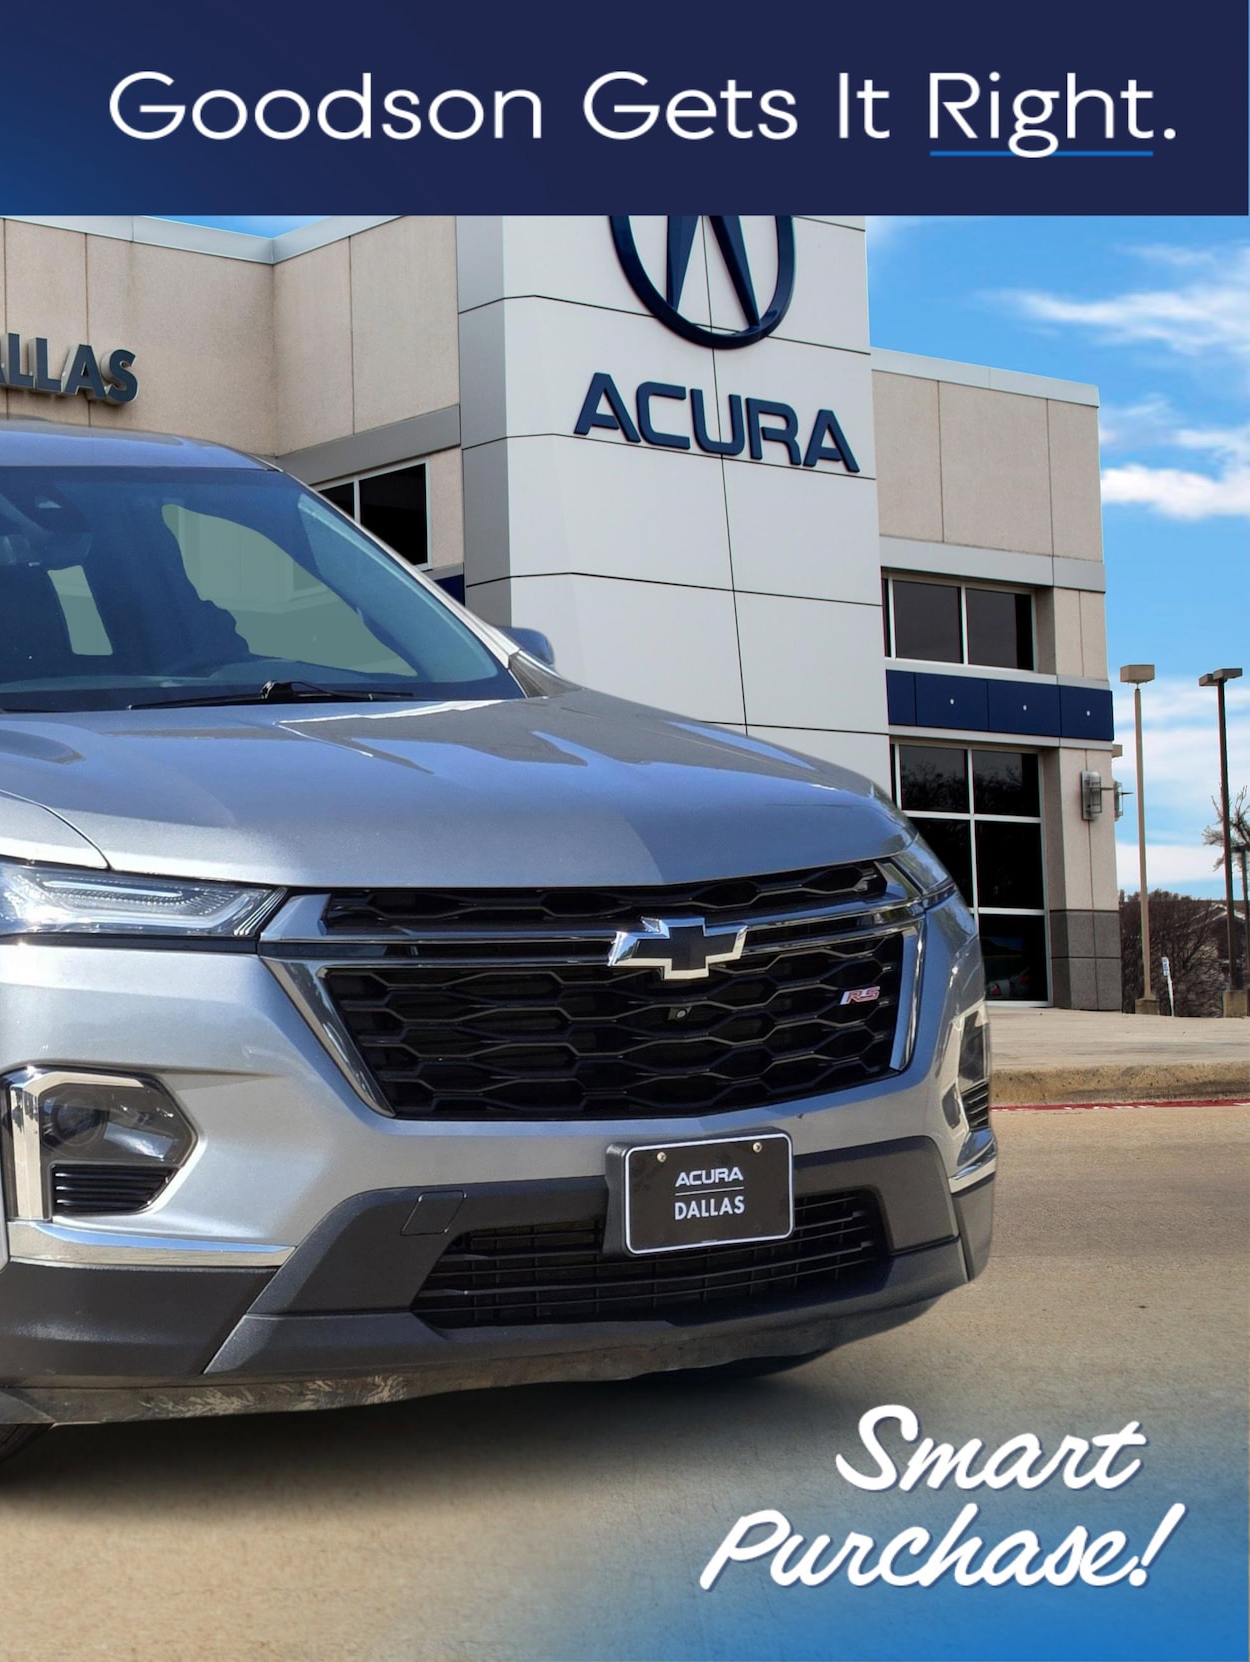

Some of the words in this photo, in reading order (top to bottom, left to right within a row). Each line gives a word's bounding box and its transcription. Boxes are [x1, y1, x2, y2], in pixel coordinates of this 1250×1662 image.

[573, 372, 860, 472] ACURA
[840, 986, 881, 1005] RS
[675, 1167, 744, 1187] ACURA
[675, 1195, 745, 1220] DALLAS
